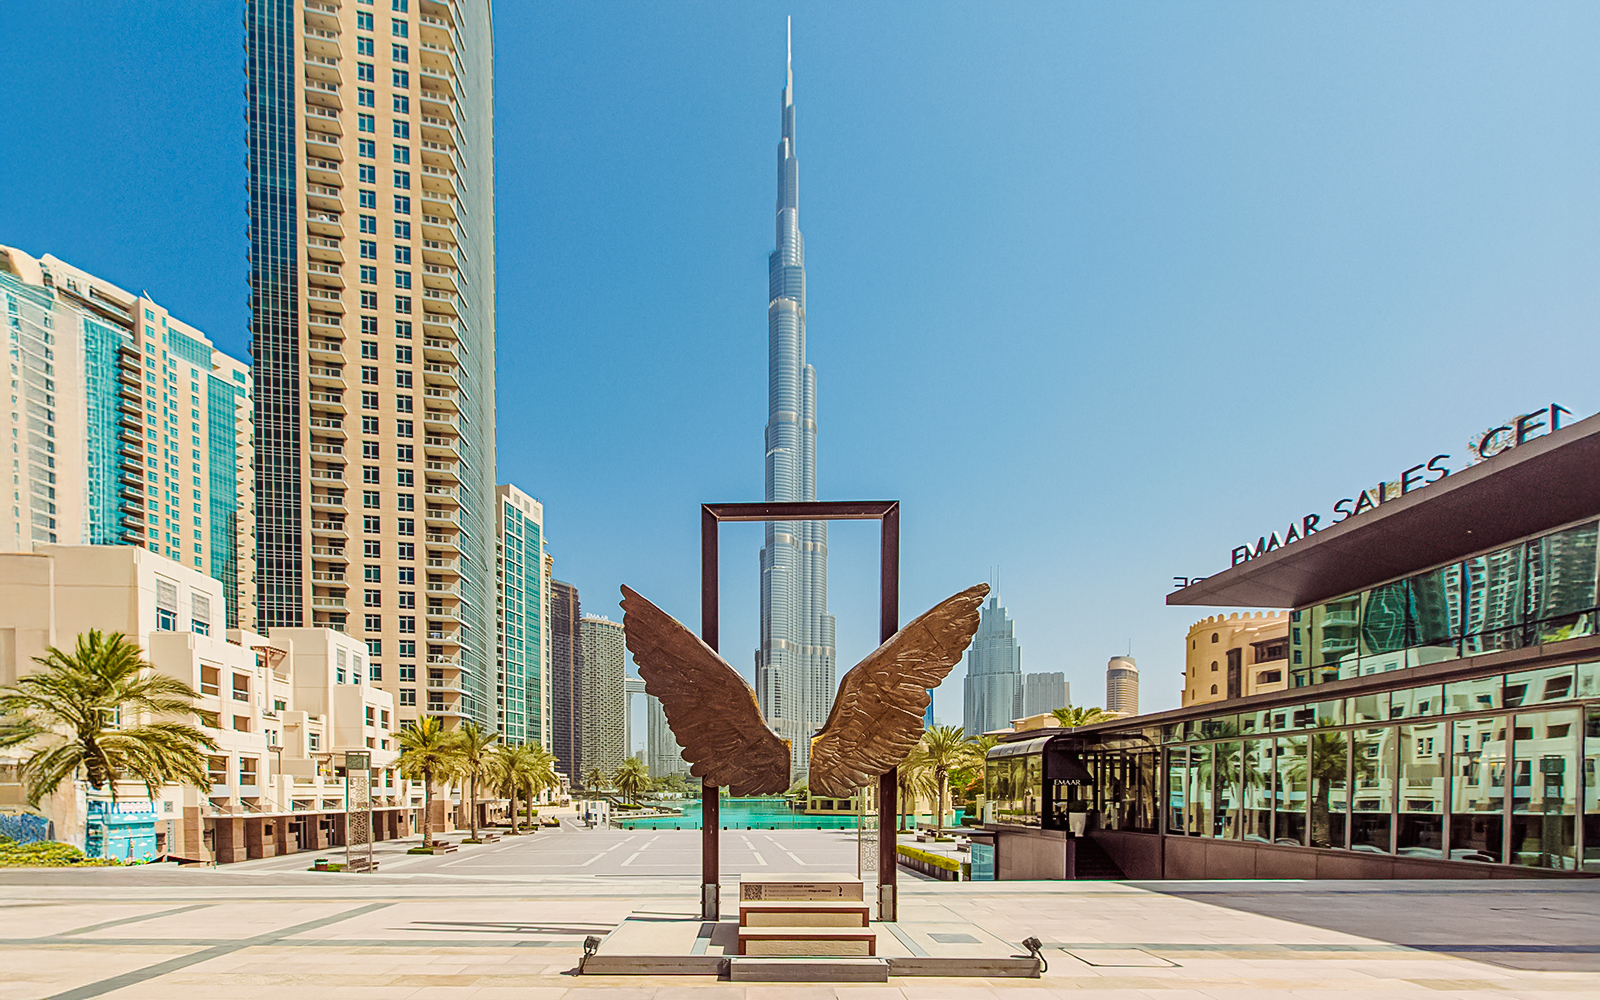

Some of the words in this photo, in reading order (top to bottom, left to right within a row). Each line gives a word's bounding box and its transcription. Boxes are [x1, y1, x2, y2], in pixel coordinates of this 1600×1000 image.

[1231, 513, 1320, 568] EMAAR
[1333, 454, 1450, 524] SALES
[586, 612, 609, 621] EMAAR
[1053, 778, 1081, 786] EMAAR
